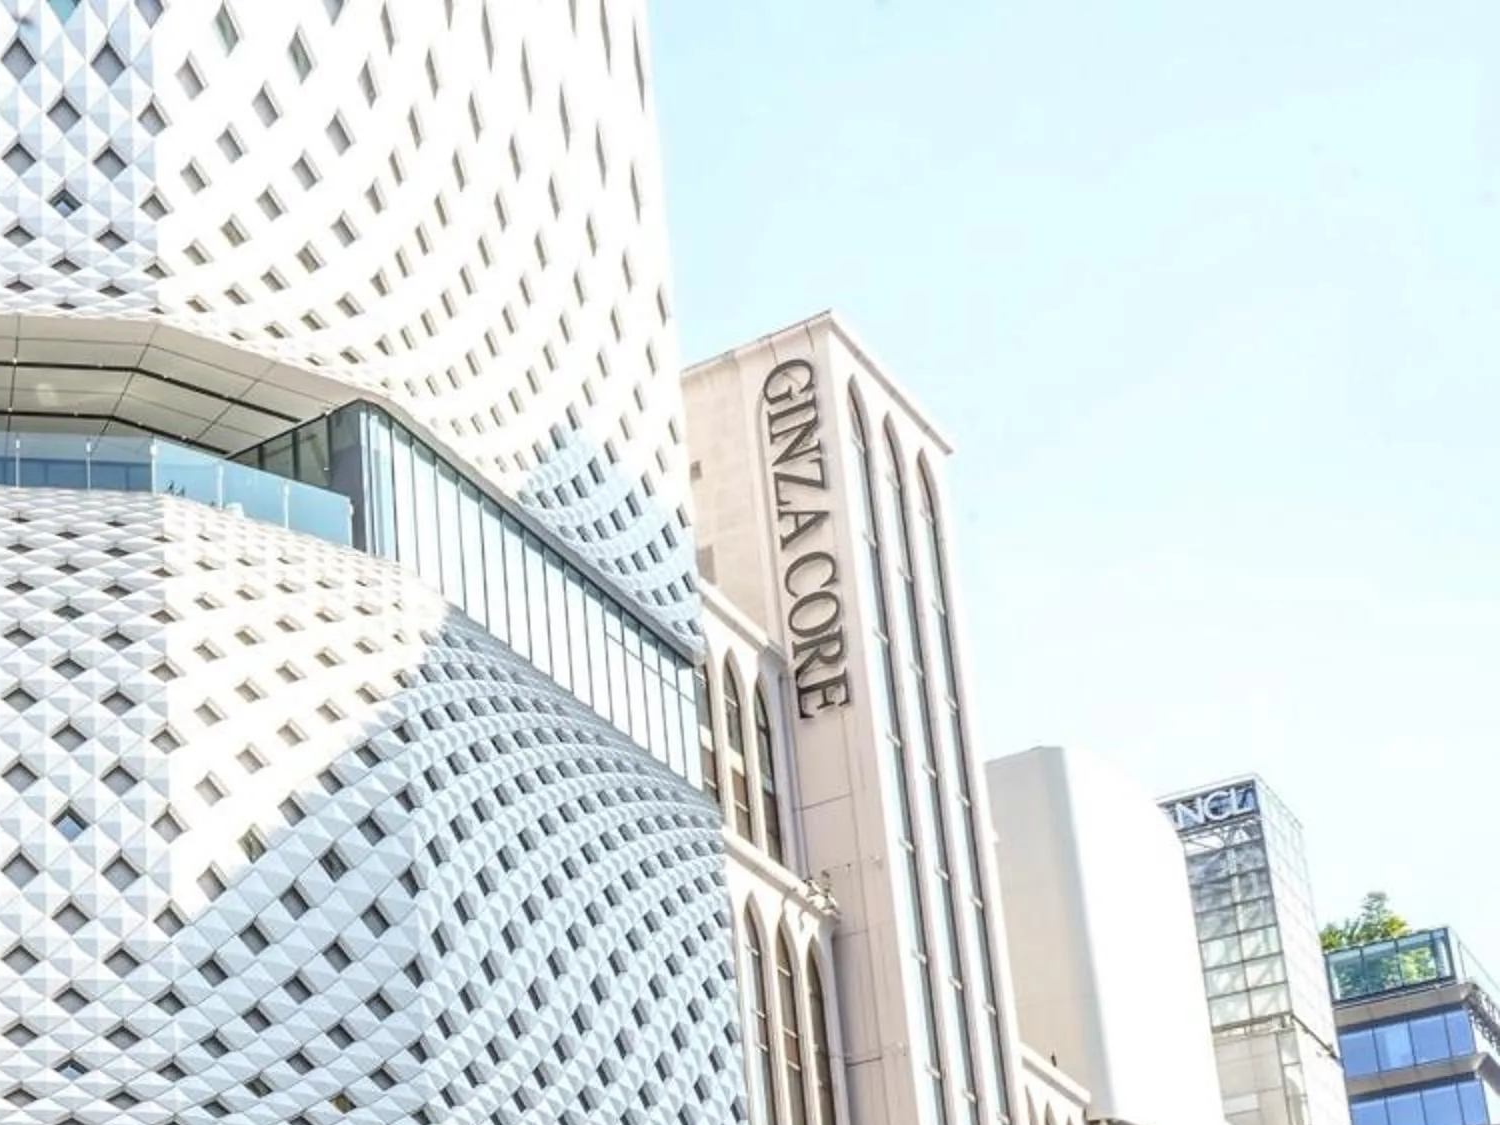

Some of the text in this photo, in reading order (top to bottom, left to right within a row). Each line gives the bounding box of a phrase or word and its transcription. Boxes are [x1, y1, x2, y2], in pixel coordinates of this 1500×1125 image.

[762, 357, 851, 721] GINZA CORE
[1173, 786, 1257, 829] NCL
